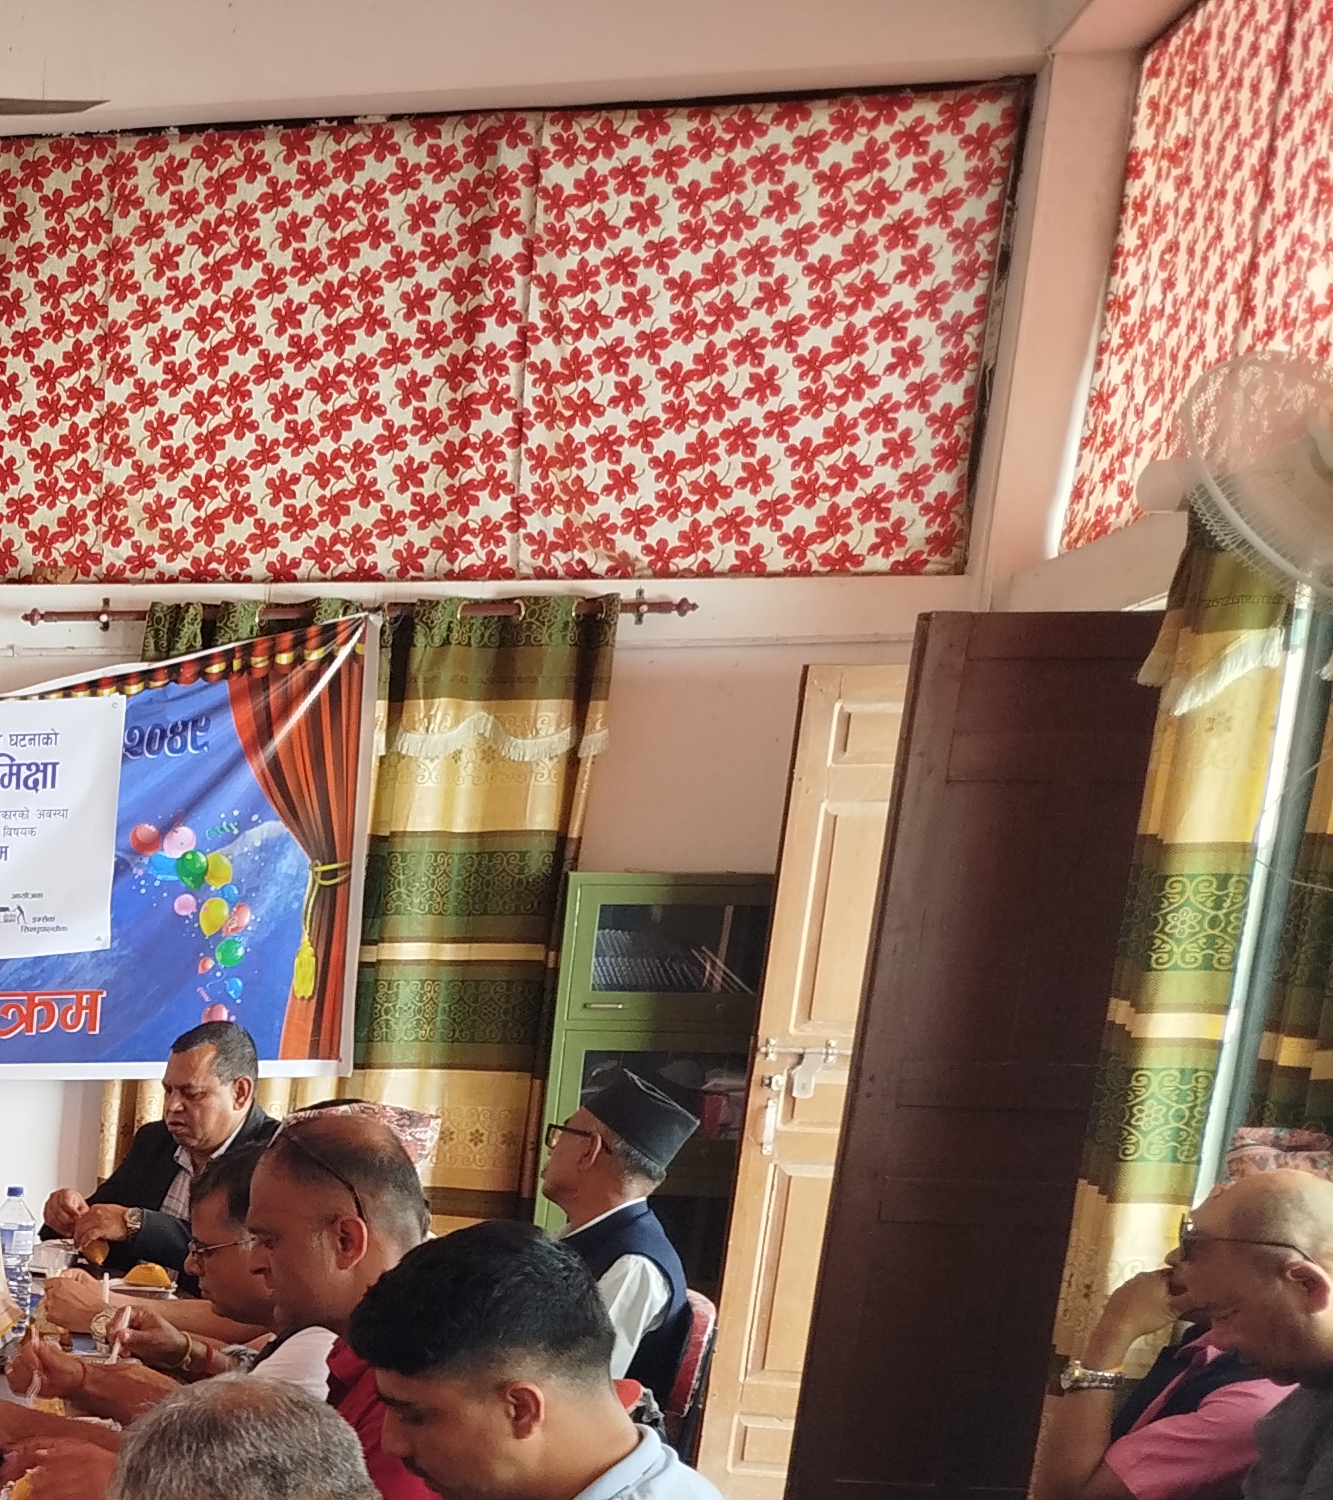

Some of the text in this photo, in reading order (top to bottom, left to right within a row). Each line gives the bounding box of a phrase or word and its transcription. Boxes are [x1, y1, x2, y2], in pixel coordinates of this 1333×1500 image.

[9, 728, 60, 747] घटनाको
[37, 808, 69, 819] अवस्था
[3, 825, 36, 838] विषयक
